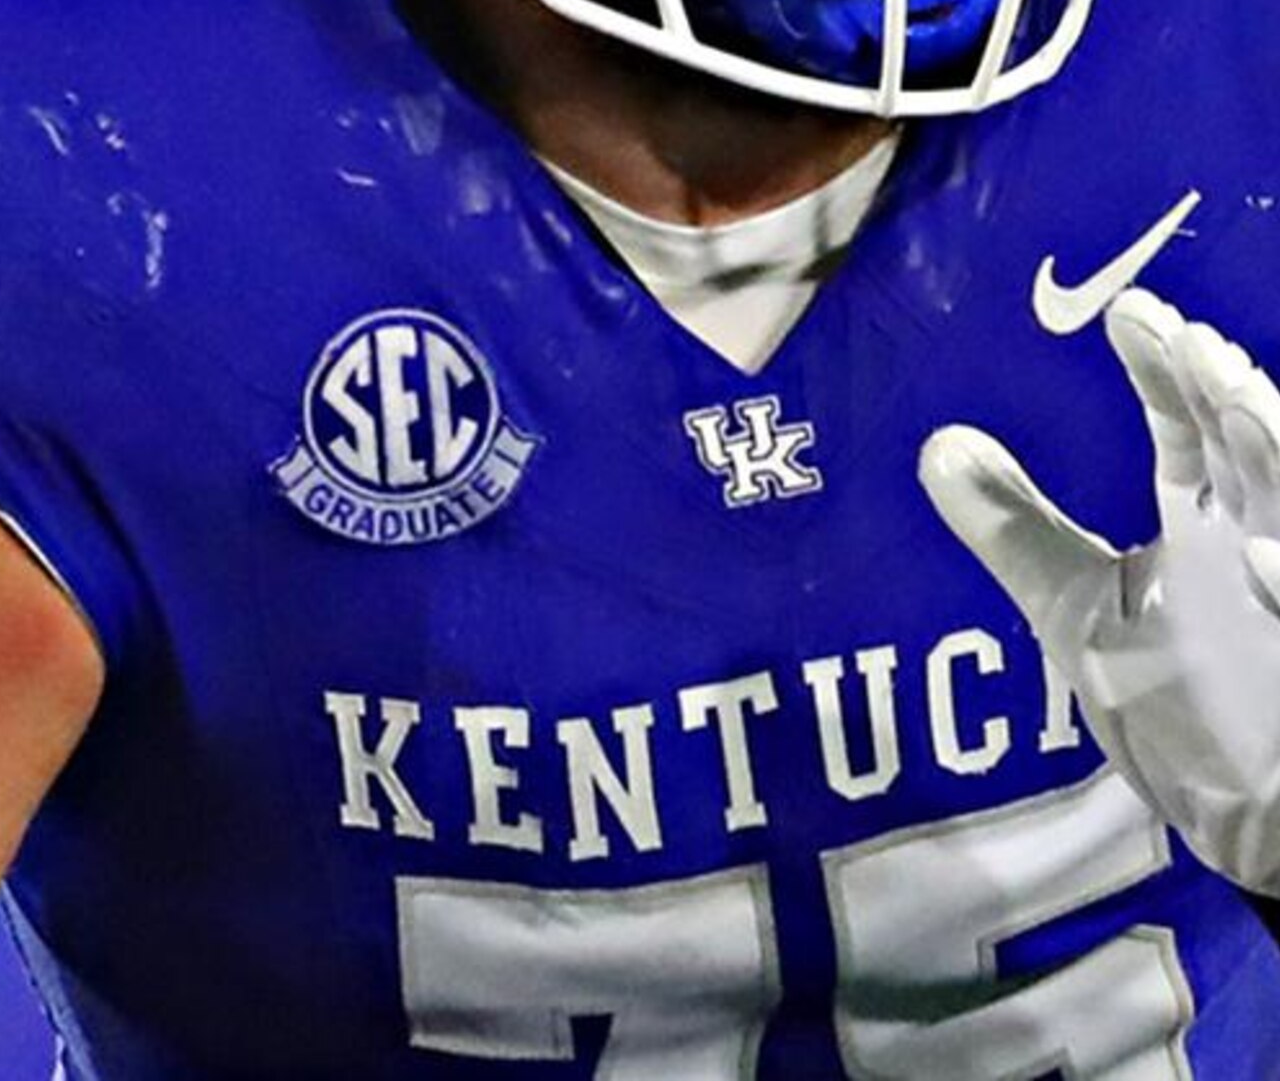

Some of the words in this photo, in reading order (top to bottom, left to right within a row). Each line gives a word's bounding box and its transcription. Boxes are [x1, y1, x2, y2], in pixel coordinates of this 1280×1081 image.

[321, 325, 479, 487] SEC
[683, 394, 823, 509] UK
[303, 471, 506, 542] GRADUATE
[394, 770, 1196, 1081] 75
